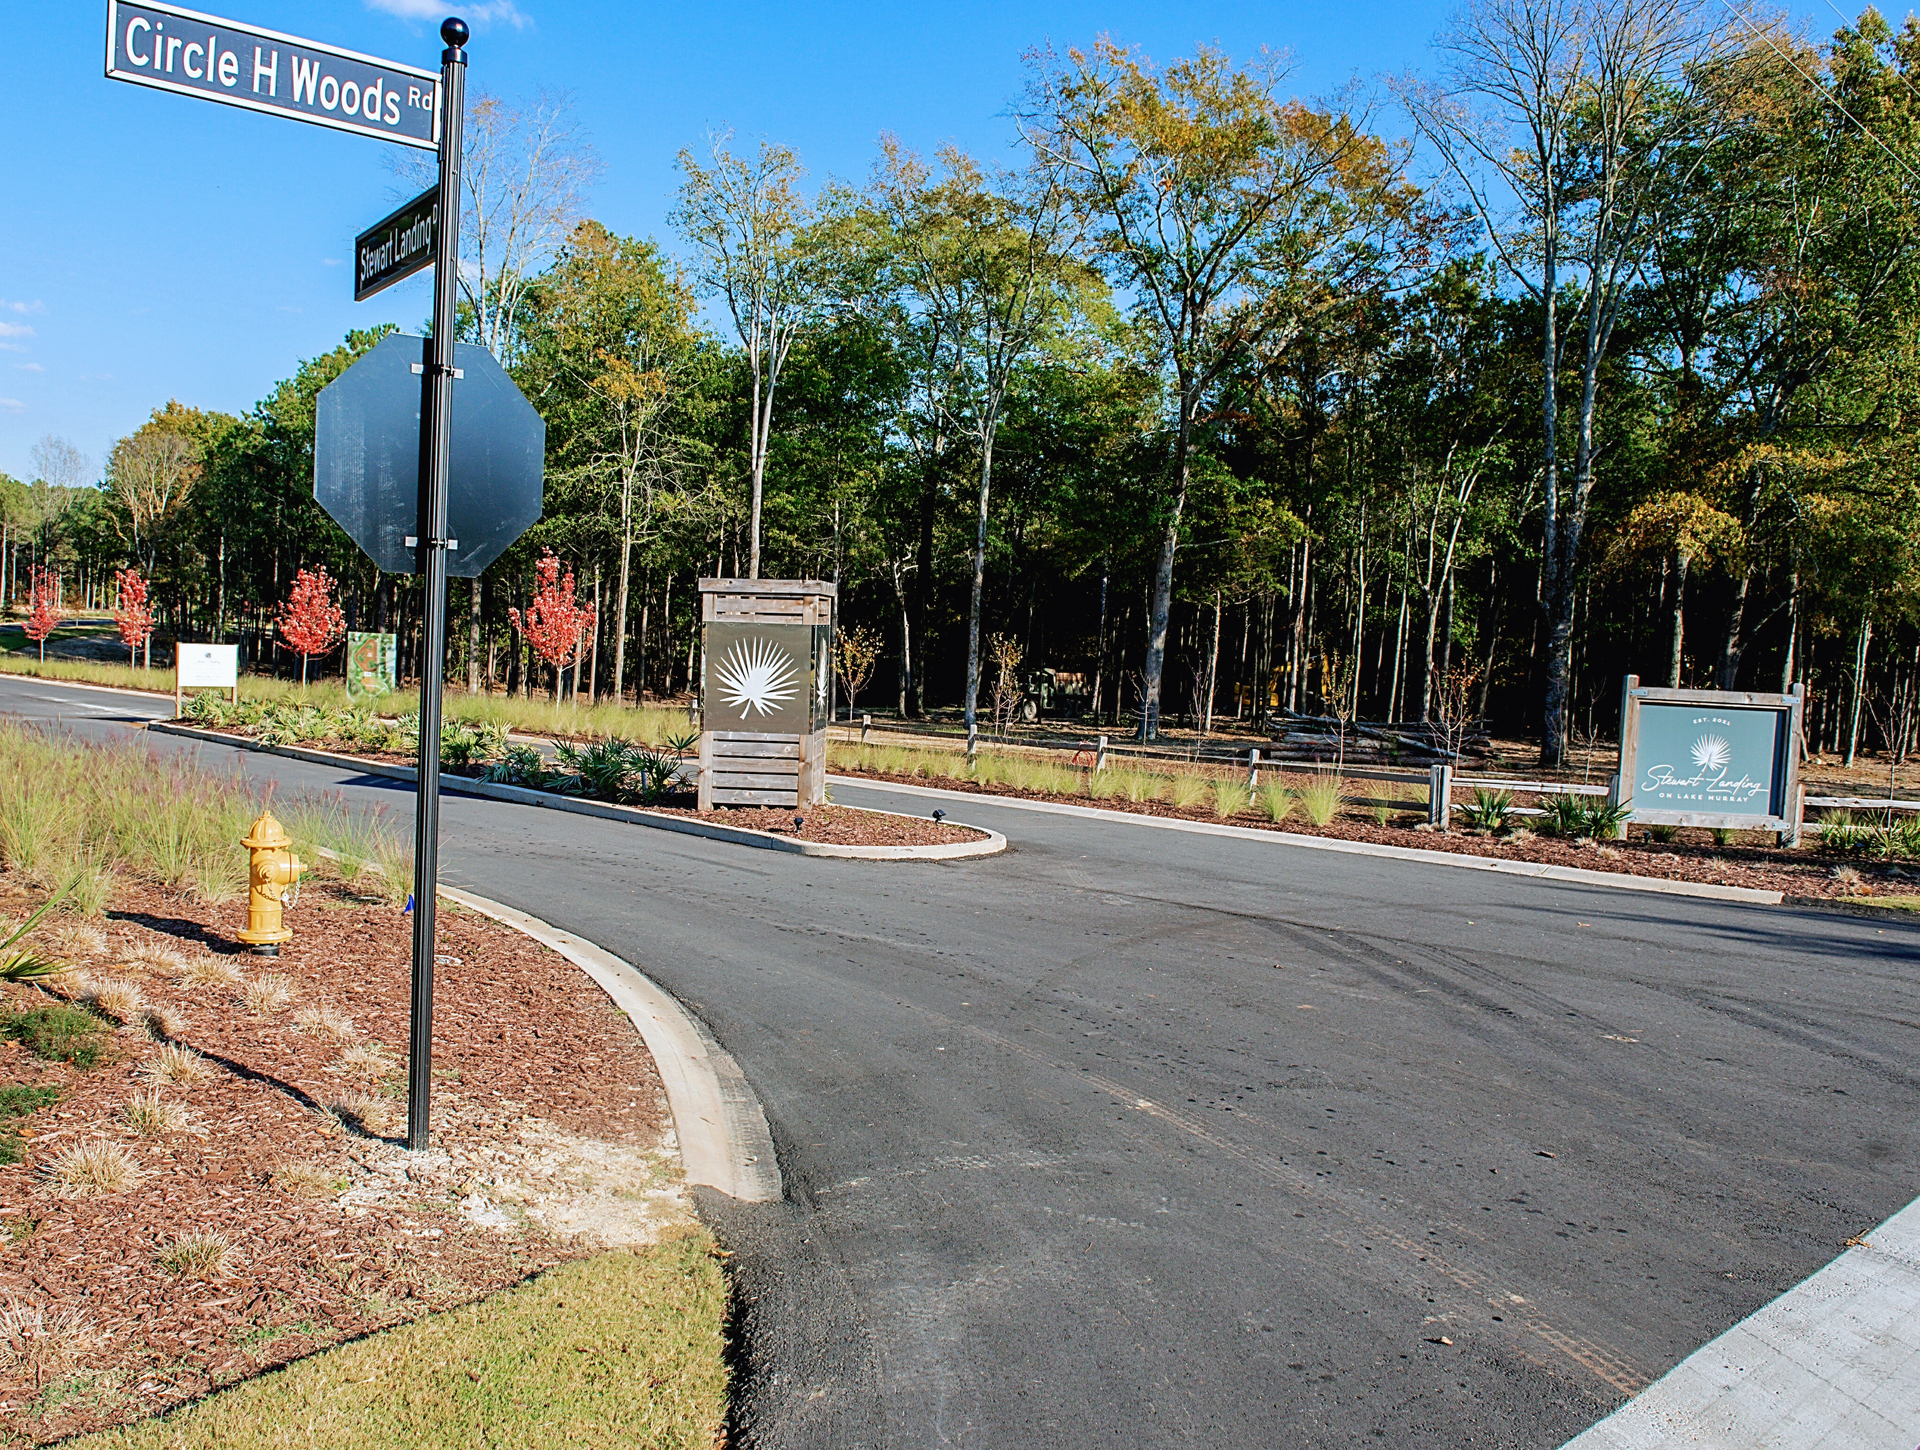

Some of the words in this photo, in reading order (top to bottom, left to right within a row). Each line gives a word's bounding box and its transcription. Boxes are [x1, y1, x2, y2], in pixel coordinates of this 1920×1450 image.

[126, 16, 239, 87] Circle
[253, 46, 278, 97] H
[291, 55, 401, 126] Woods
[408, 86, 433, 112] Rd
[361, 231, 393, 281] Stewart
[395, 213, 432, 255] Landing
[432, 203, 438, 225] D
[1693, 717, 1710, 725] EST.
[1712, 717, 1731, 726] 2021
[1641, 764, 1704, 792] Stewart
[1705, 766, 1769, 797] Landing
[1677, 793, 1703, 801] LAKE
[1708, 795, 1749, 803] MURRAY
